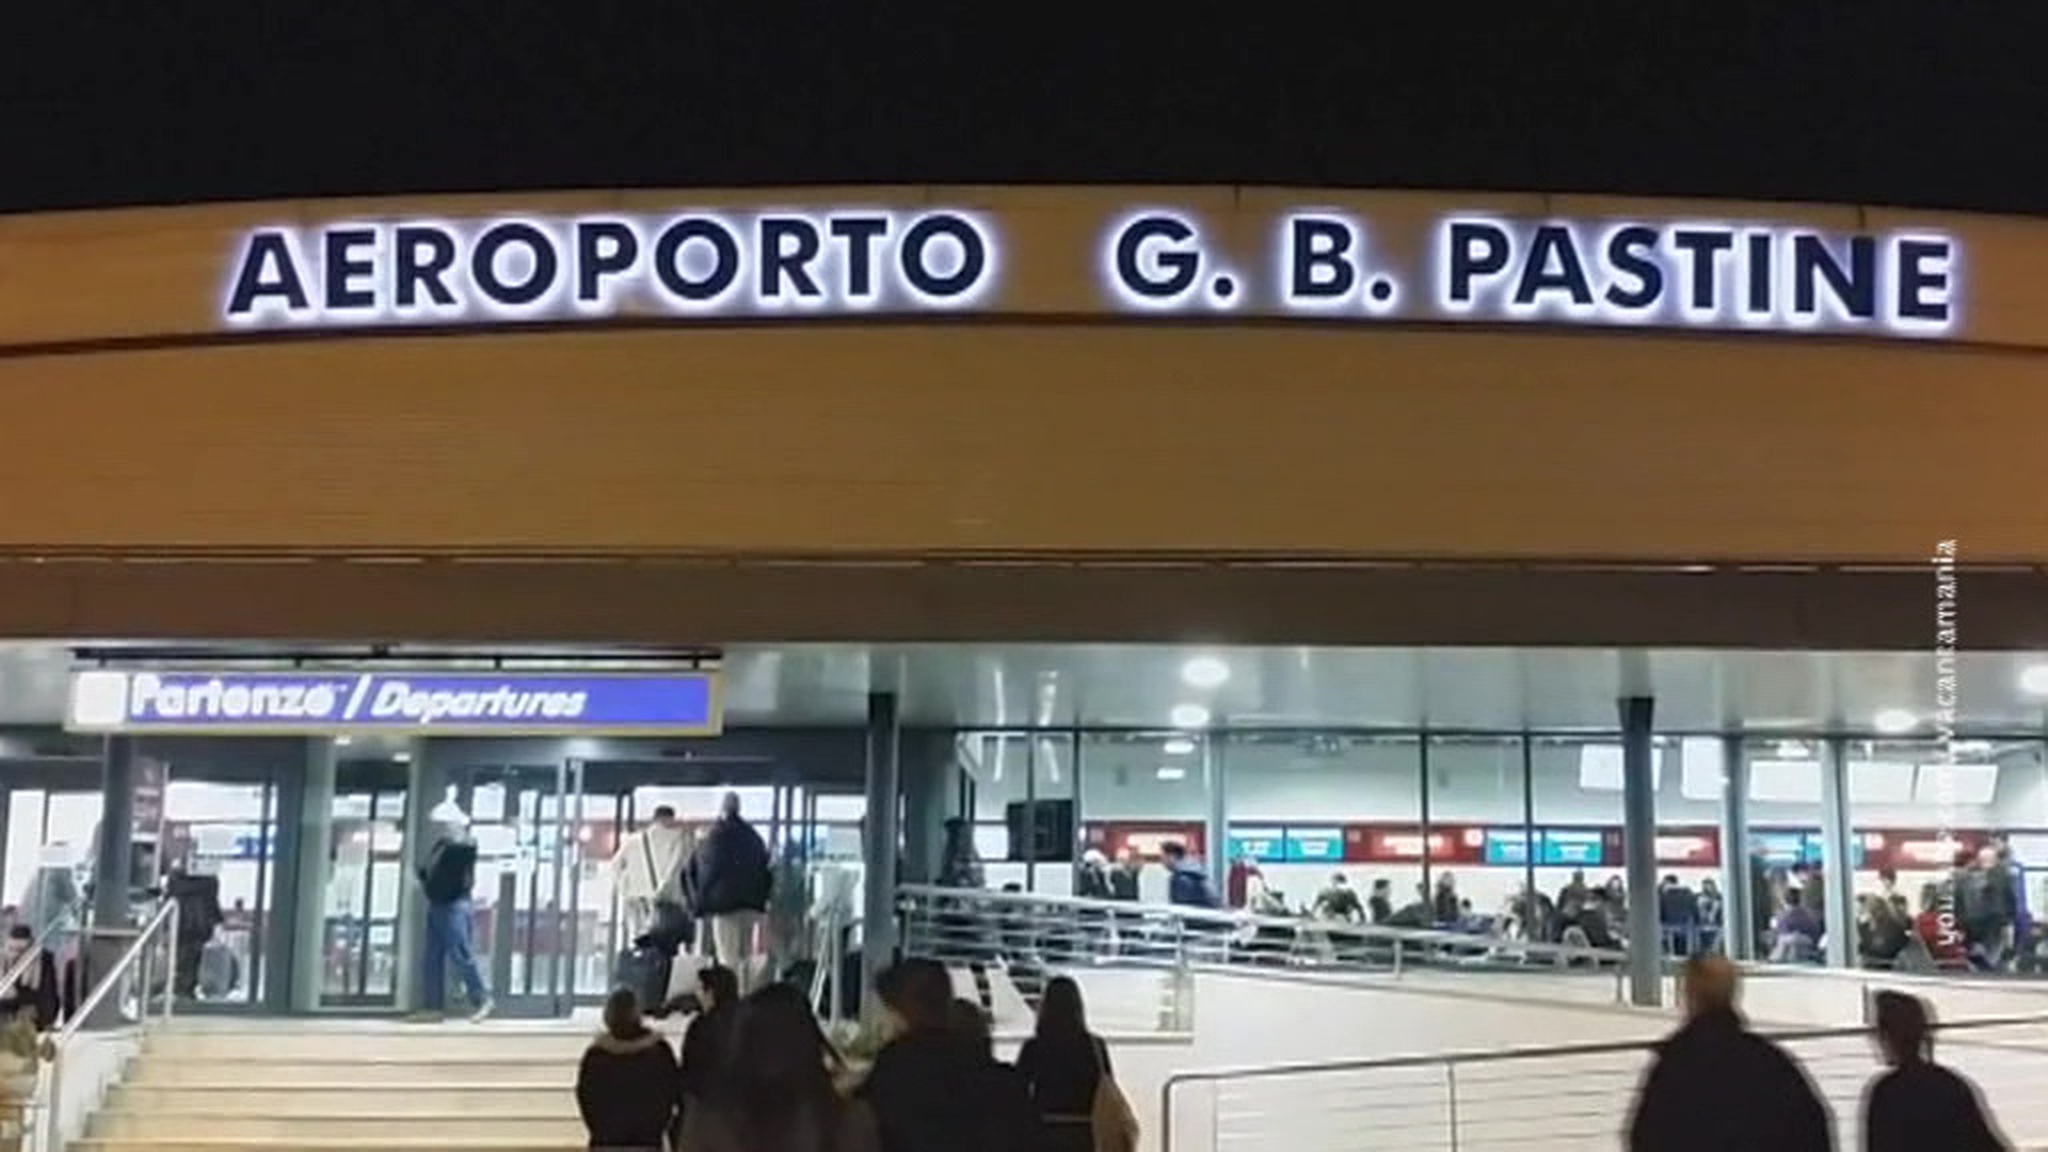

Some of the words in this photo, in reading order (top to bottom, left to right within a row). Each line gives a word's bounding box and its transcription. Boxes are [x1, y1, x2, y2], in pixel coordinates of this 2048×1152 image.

[228, 214, 986, 314] AEROPORTO
[1115, 217, 1235, 300] G.
[1292, 218, 1393, 302] B.
[1448, 221, 1950, 322] PASTINE
[370, 681, 588, 724] Departures
